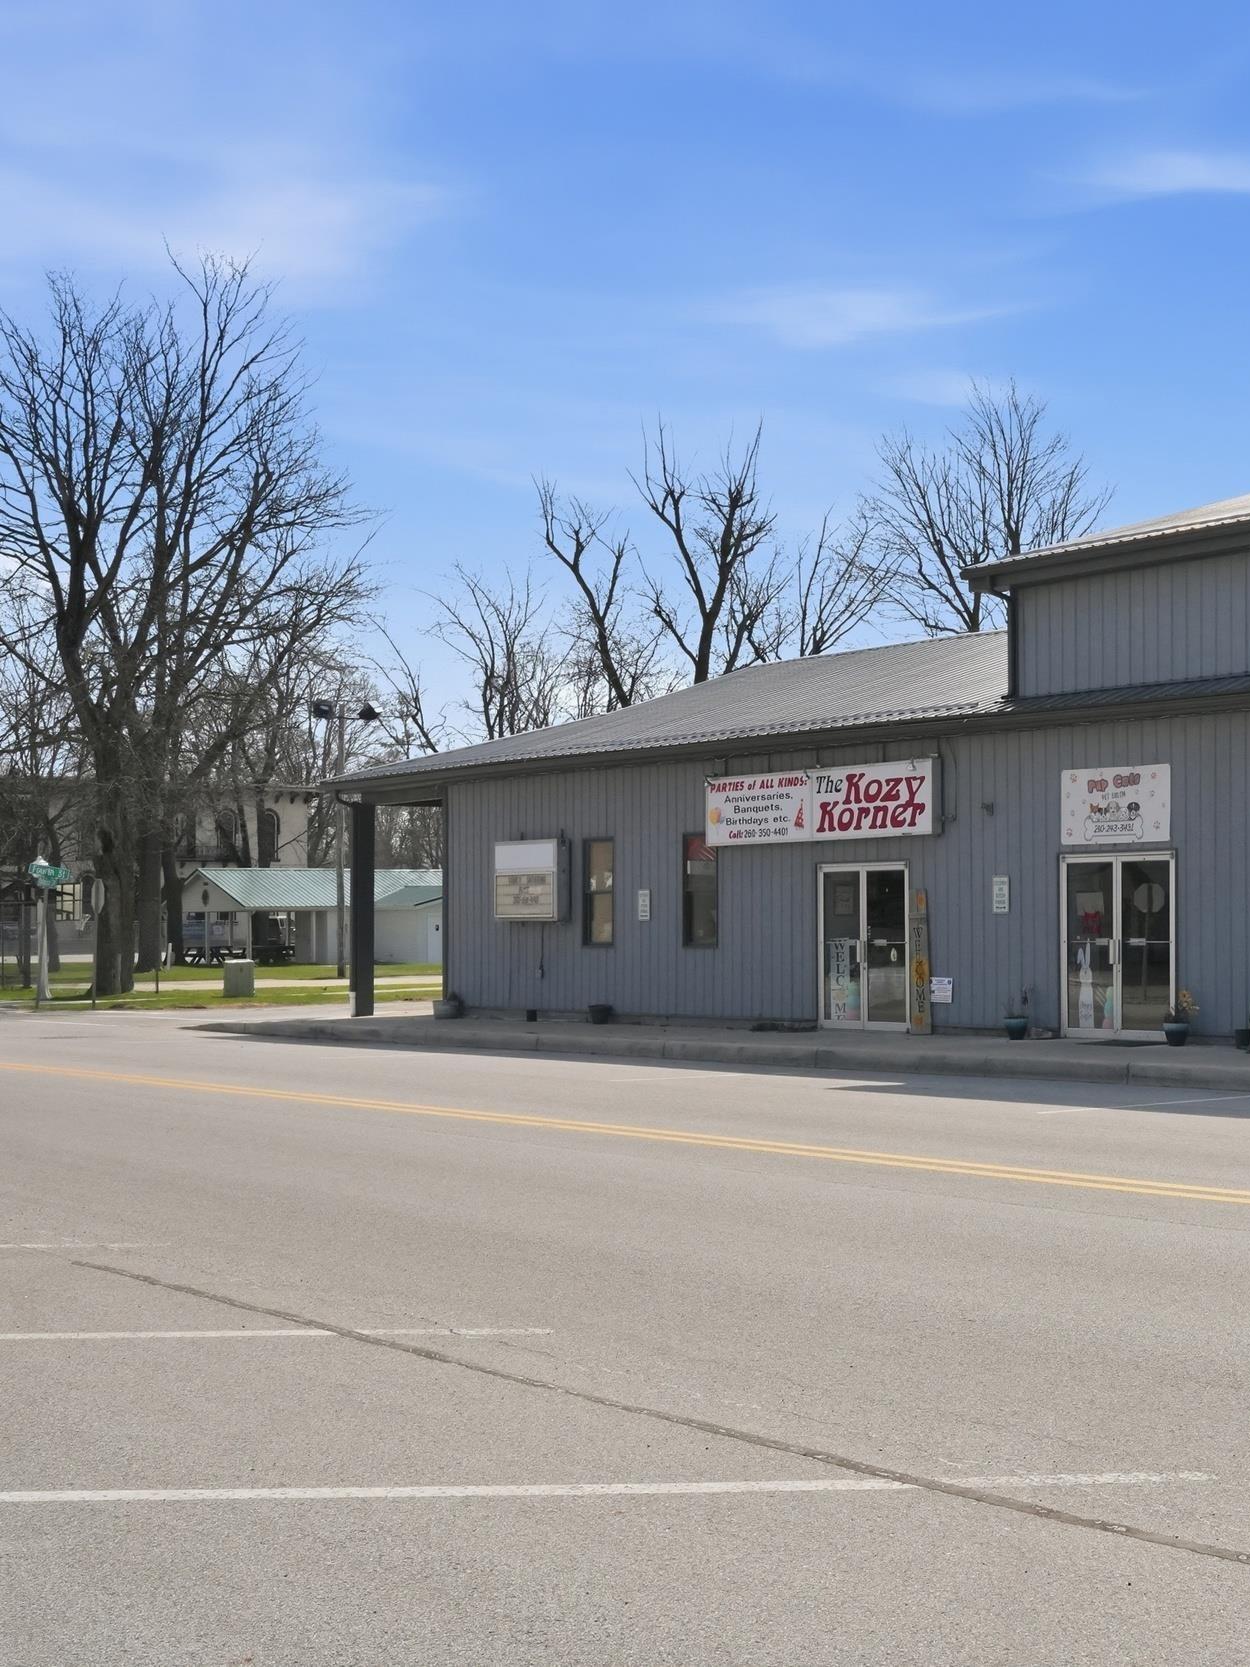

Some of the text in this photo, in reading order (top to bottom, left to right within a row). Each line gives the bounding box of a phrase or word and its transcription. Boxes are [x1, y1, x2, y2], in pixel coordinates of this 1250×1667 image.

[710, 781, 745, 793] PARTIES
[747, 780, 757, 791] of
[759, 778, 774, 790] ALL
[816, 772, 926, 806] The Kozy
[725, 816, 769, 826] Birthdays
[816, 800, 926, 833] Korner
